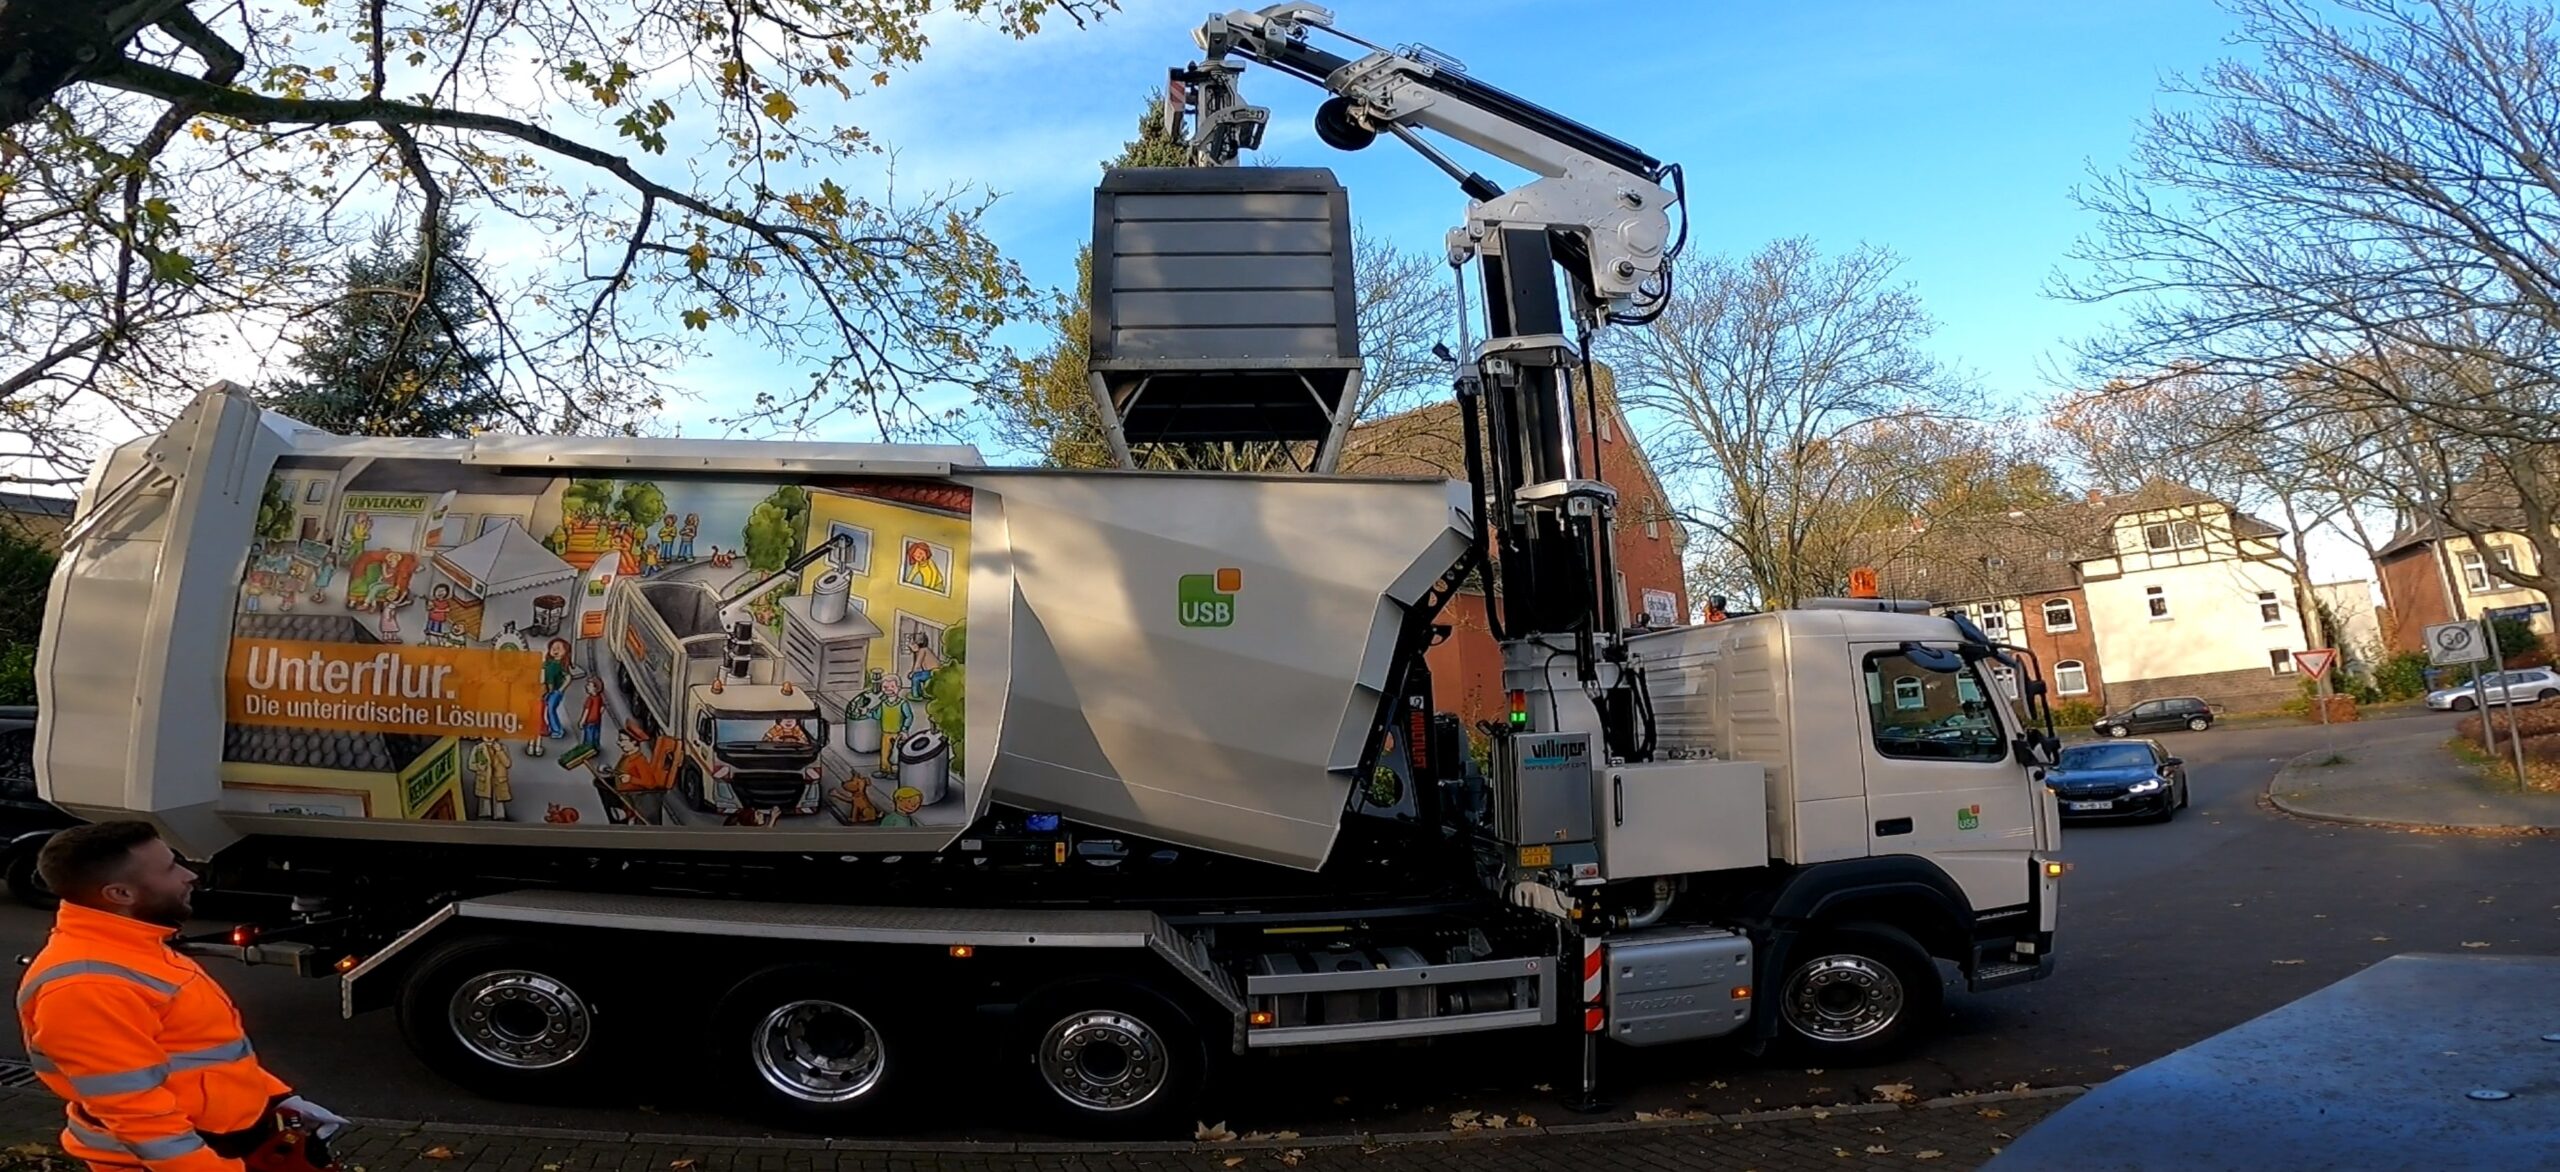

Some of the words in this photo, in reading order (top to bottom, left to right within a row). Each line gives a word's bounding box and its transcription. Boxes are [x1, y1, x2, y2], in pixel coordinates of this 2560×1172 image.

[1182, 601, 1230, 623] USB
[2444, 632, 2465, 645] 30
[247, 646, 457, 699] Unterflur.
[245, 694, 279, 716] Die
[287, 698, 429, 725] unterirdische
[435, 703, 523, 733] Lösung.
[1410, 711, 1426, 768] MULTILIFT
[1531, 739, 1586, 761] villiger
[1960, 818, 1977, 829] USB
